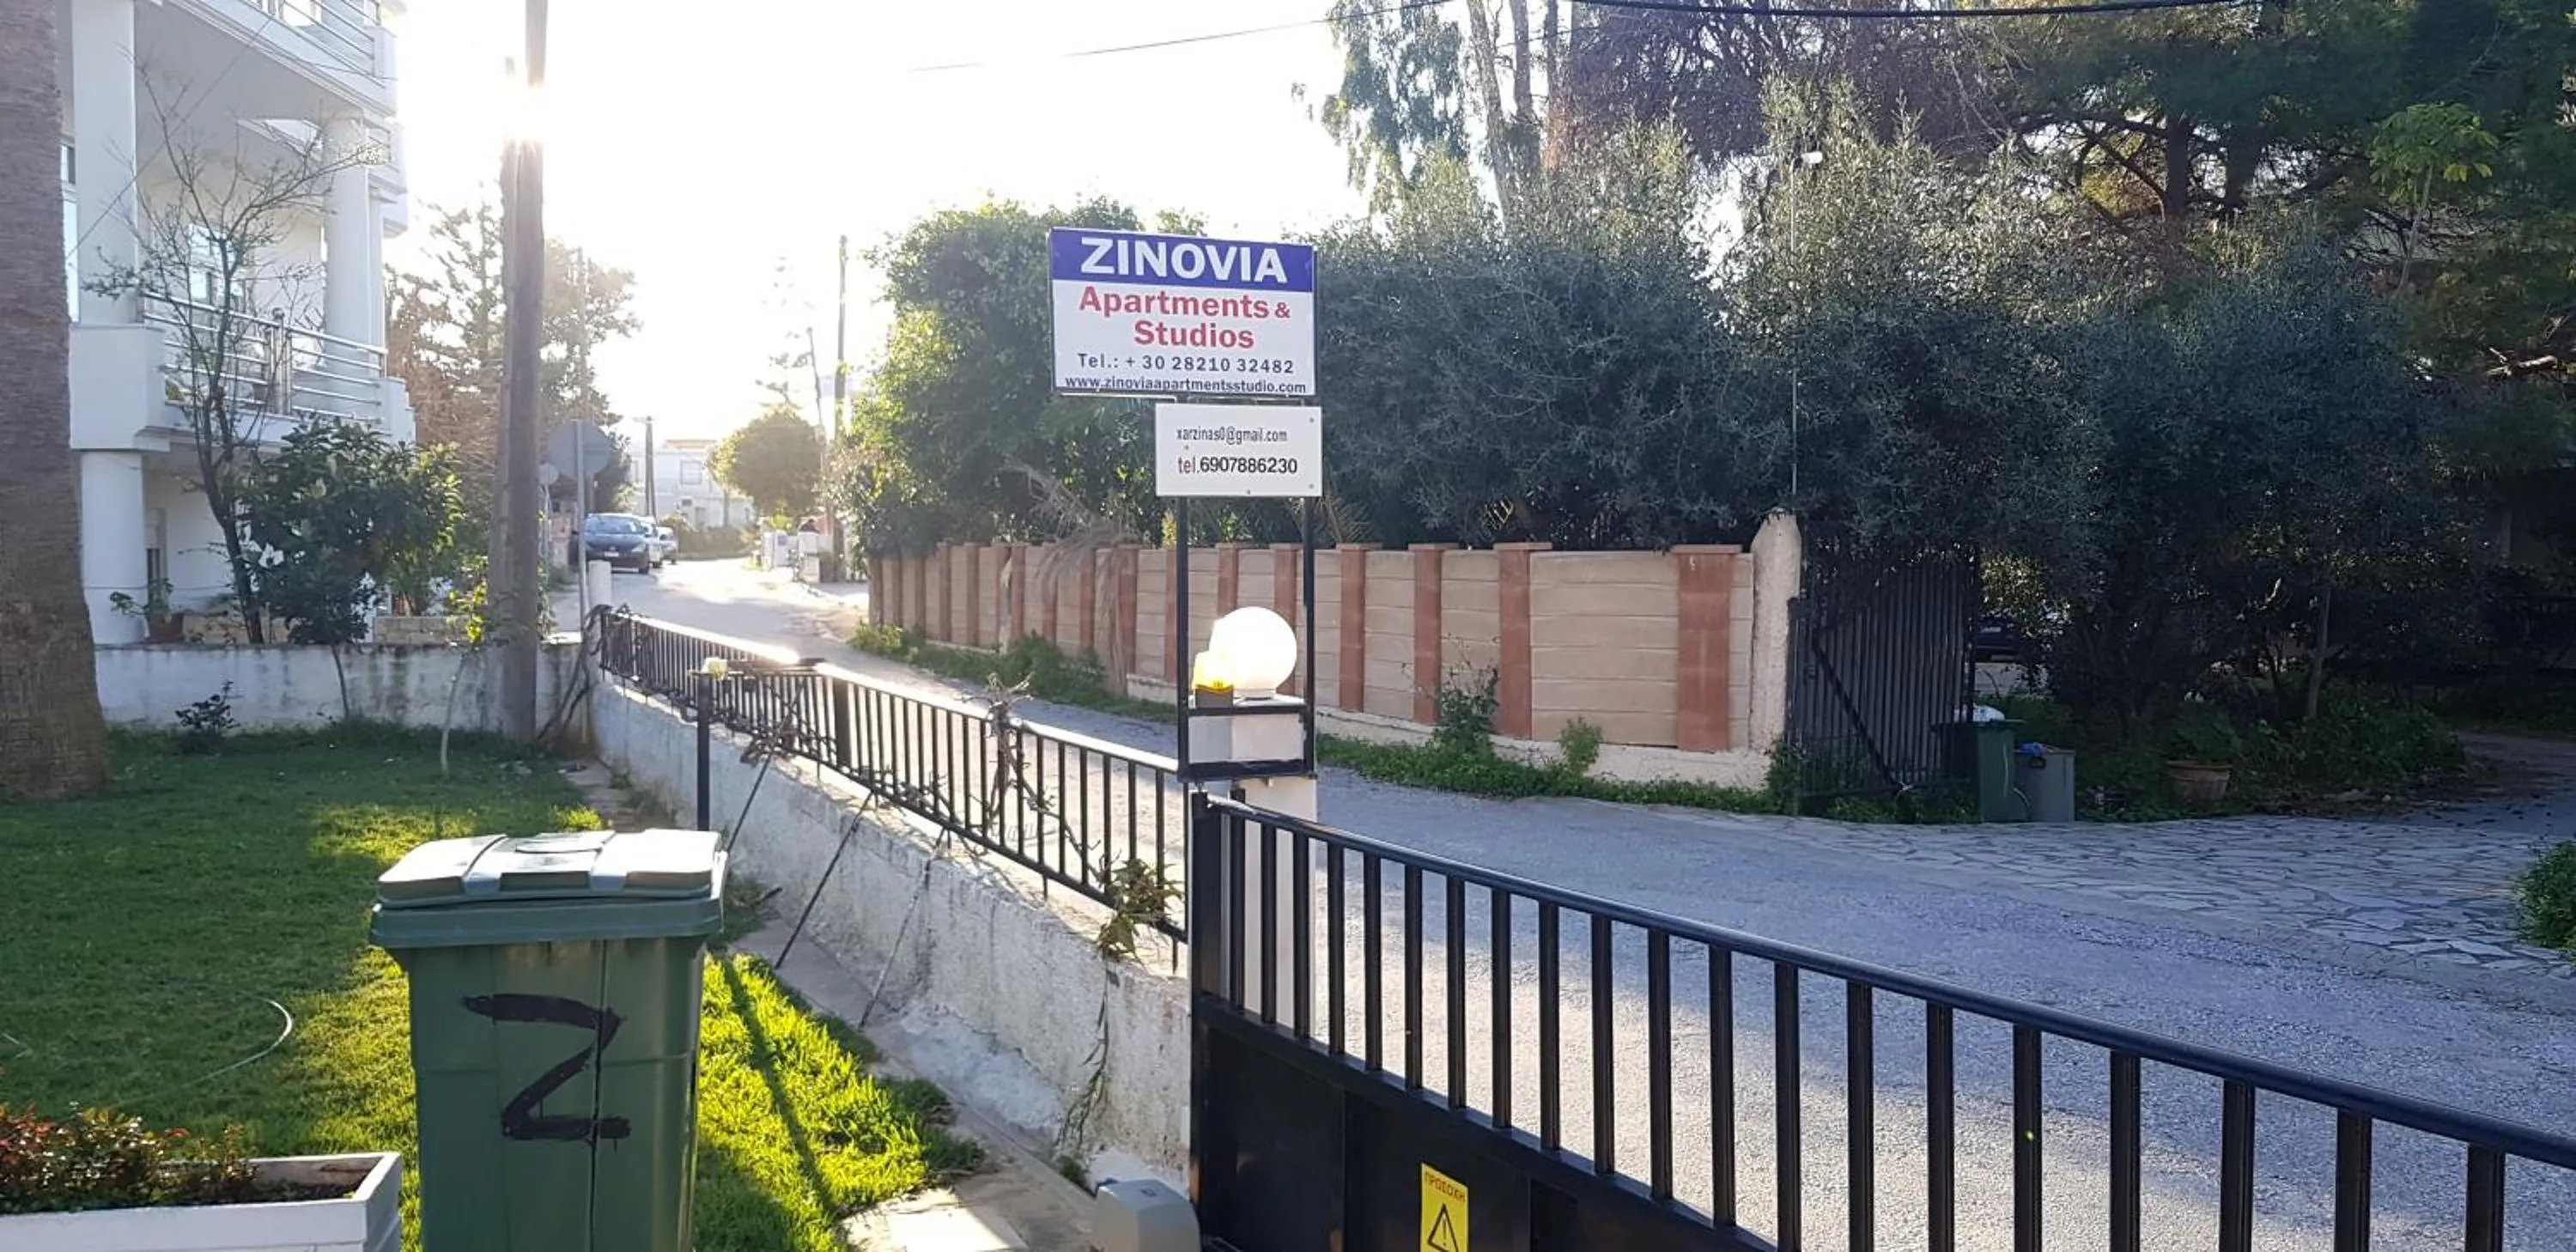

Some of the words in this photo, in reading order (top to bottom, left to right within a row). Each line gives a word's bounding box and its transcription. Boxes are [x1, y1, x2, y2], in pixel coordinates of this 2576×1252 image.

[1080, 236, 1287, 284] ZINOVIA
[1079, 286, 1269, 319] Apartments
[1275, 301, 1291, 319] &
[1133, 320, 1255, 349] Studios
[1078, 353, 1118, 369] Tel.:
[1127, 357, 1136, 368] +
[1142, 356, 1164, 370] 30
[1172, 356, 1230, 372] 28210
[1237, 359, 1294, 374] 32482
[1065, 375, 1306, 394] www.zinoviaapartmentsstudio.com
